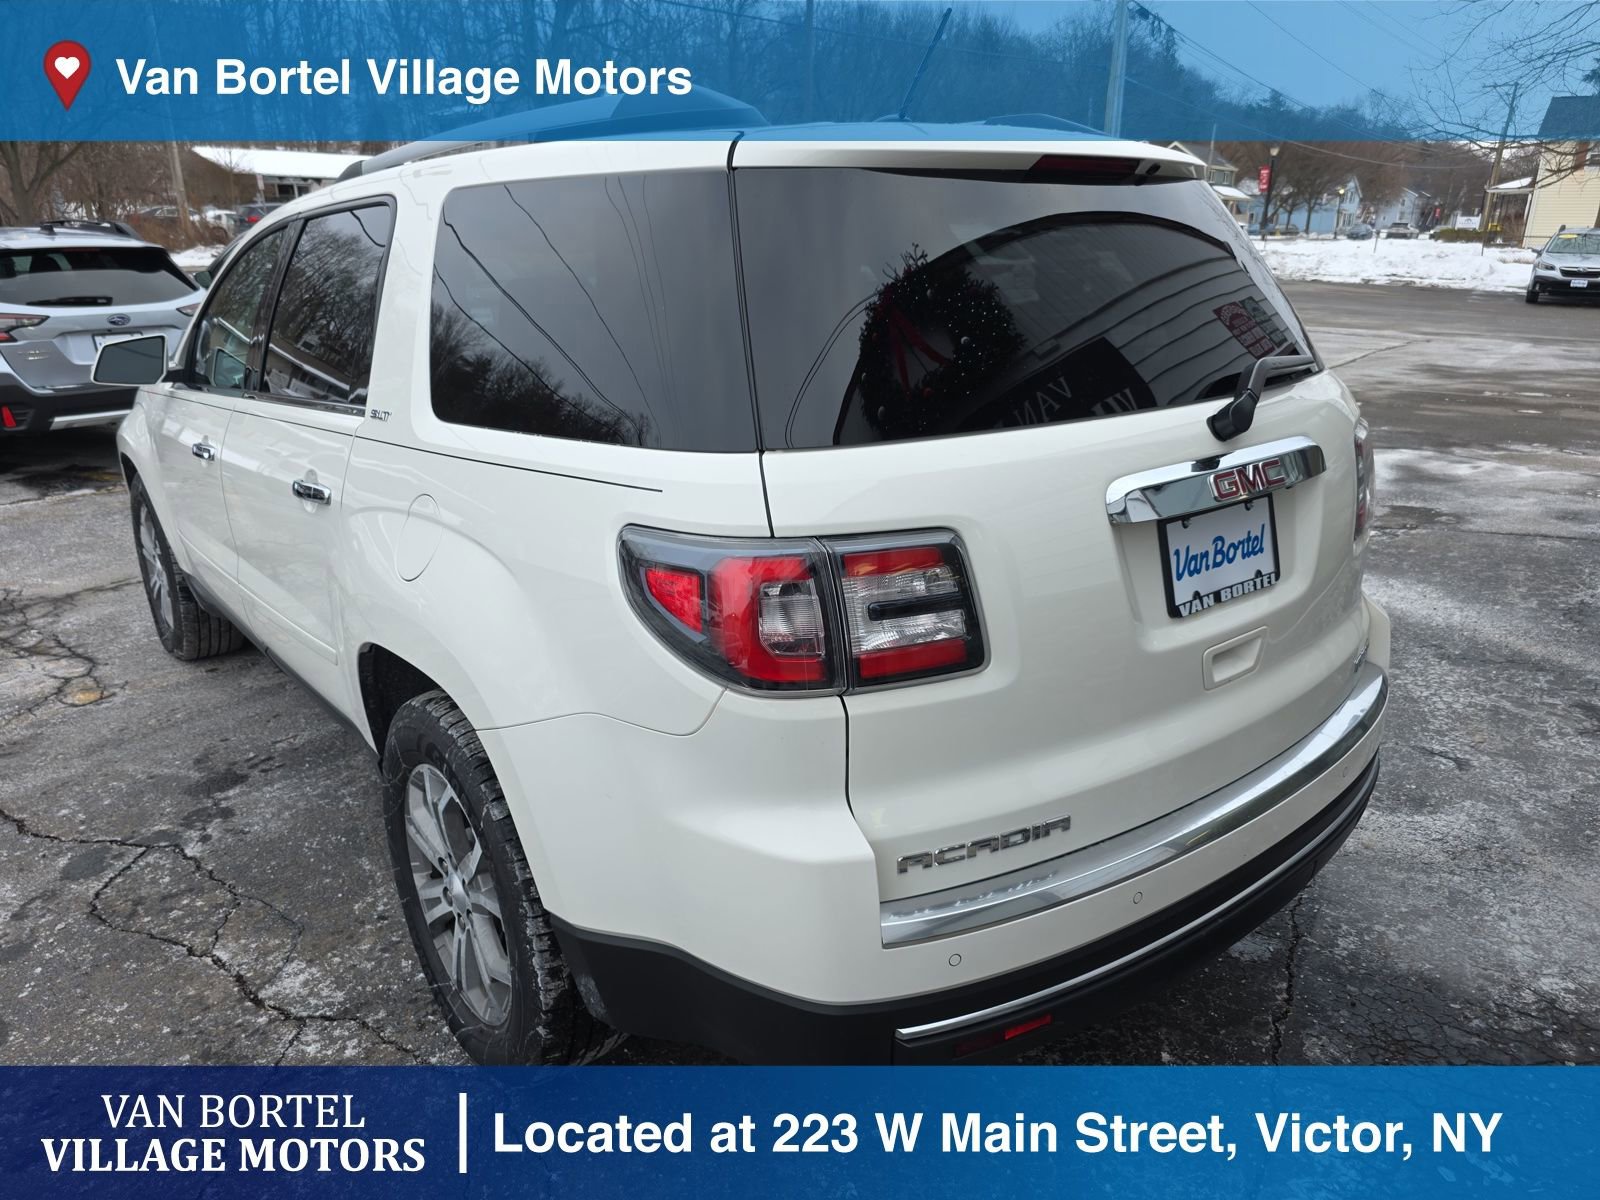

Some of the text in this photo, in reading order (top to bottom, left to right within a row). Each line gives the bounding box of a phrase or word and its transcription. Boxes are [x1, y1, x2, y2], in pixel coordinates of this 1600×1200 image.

[1209, 457, 1287, 501] GMC
[1173, 523, 1265, 582] Van Bortel
[1178, 572, 1278, 617] VAN BORTEL
[896, 814, 1072, 875] ACADIA
